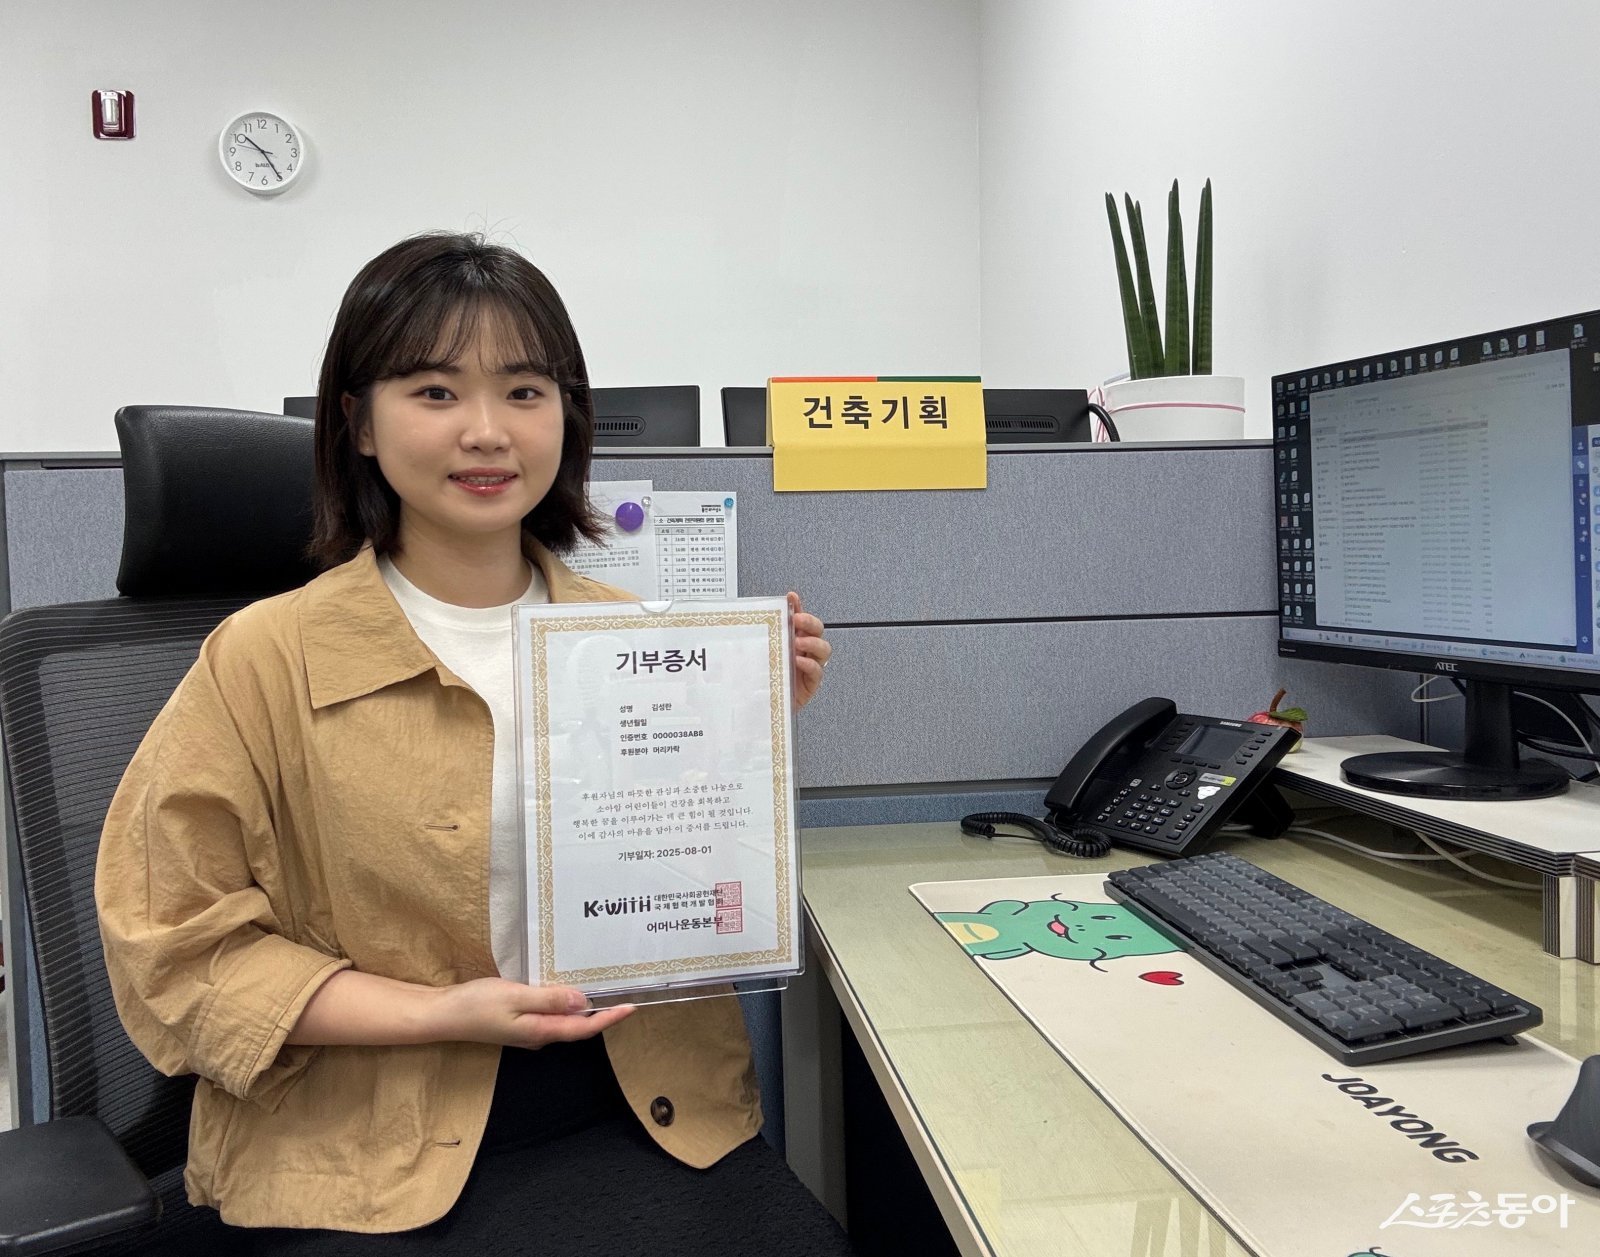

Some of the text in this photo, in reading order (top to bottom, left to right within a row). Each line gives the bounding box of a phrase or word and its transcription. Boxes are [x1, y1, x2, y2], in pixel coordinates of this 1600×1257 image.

[244, 123, 252, 133] 11
[257, 119, 267, 129] 12
[275, 124, 279, 133] 1
[233, 133, 247, 143] 10
[285, 134, 292, 143] 2
[229, 147, 236, 157] 9
[290, 148, 298, 158] 3
[235, 161, 242, 171] 8
[287, 163, 293, 172] 4
[248, 172, 255, 182] 7
[261, 176, 268, 186] 6
[803, 396, 948, 429] 건축기획
[616, 648, 707, 674] 기부증서
[620, 705, 633, 713] 성명
[620, 718, 647, 727] 생년월일
[620, 733, 648, 742] 인증번호
[621, 745, 680, 756] 후원분야 머리카락
[582, 783, 744, 801] 후원자님의 따뜻한 관심과 소중한 나눔으로
[597, 796, 731, 813] 소아암 어린이들이 건강을 회복하고
[573, 819, 598, 828] 행복한
[602, 817, 618, 826] 꿈을
[621, 814, 663, 824] 이루어가는
[689, 810, 704, 819] 힘이
[579, 831, 595, 840] 이에
[599, 829, 624, 839] 감사의
[627, 827, 652, 836] 마음을
[656, 825, 672, 834] 담아
[686, 822, 711, 832] 증서를
[714, 820, 748, 829] 드립니다.
[618, 846, 712, 861] 기부일자: 2025-08-01
[654, 888, 723, 901] 대한민국사회공헌재단
[647, 916, 724, 933] 어머나운동본부
[1321, 1073, 1480, 1164] JOAYONG
